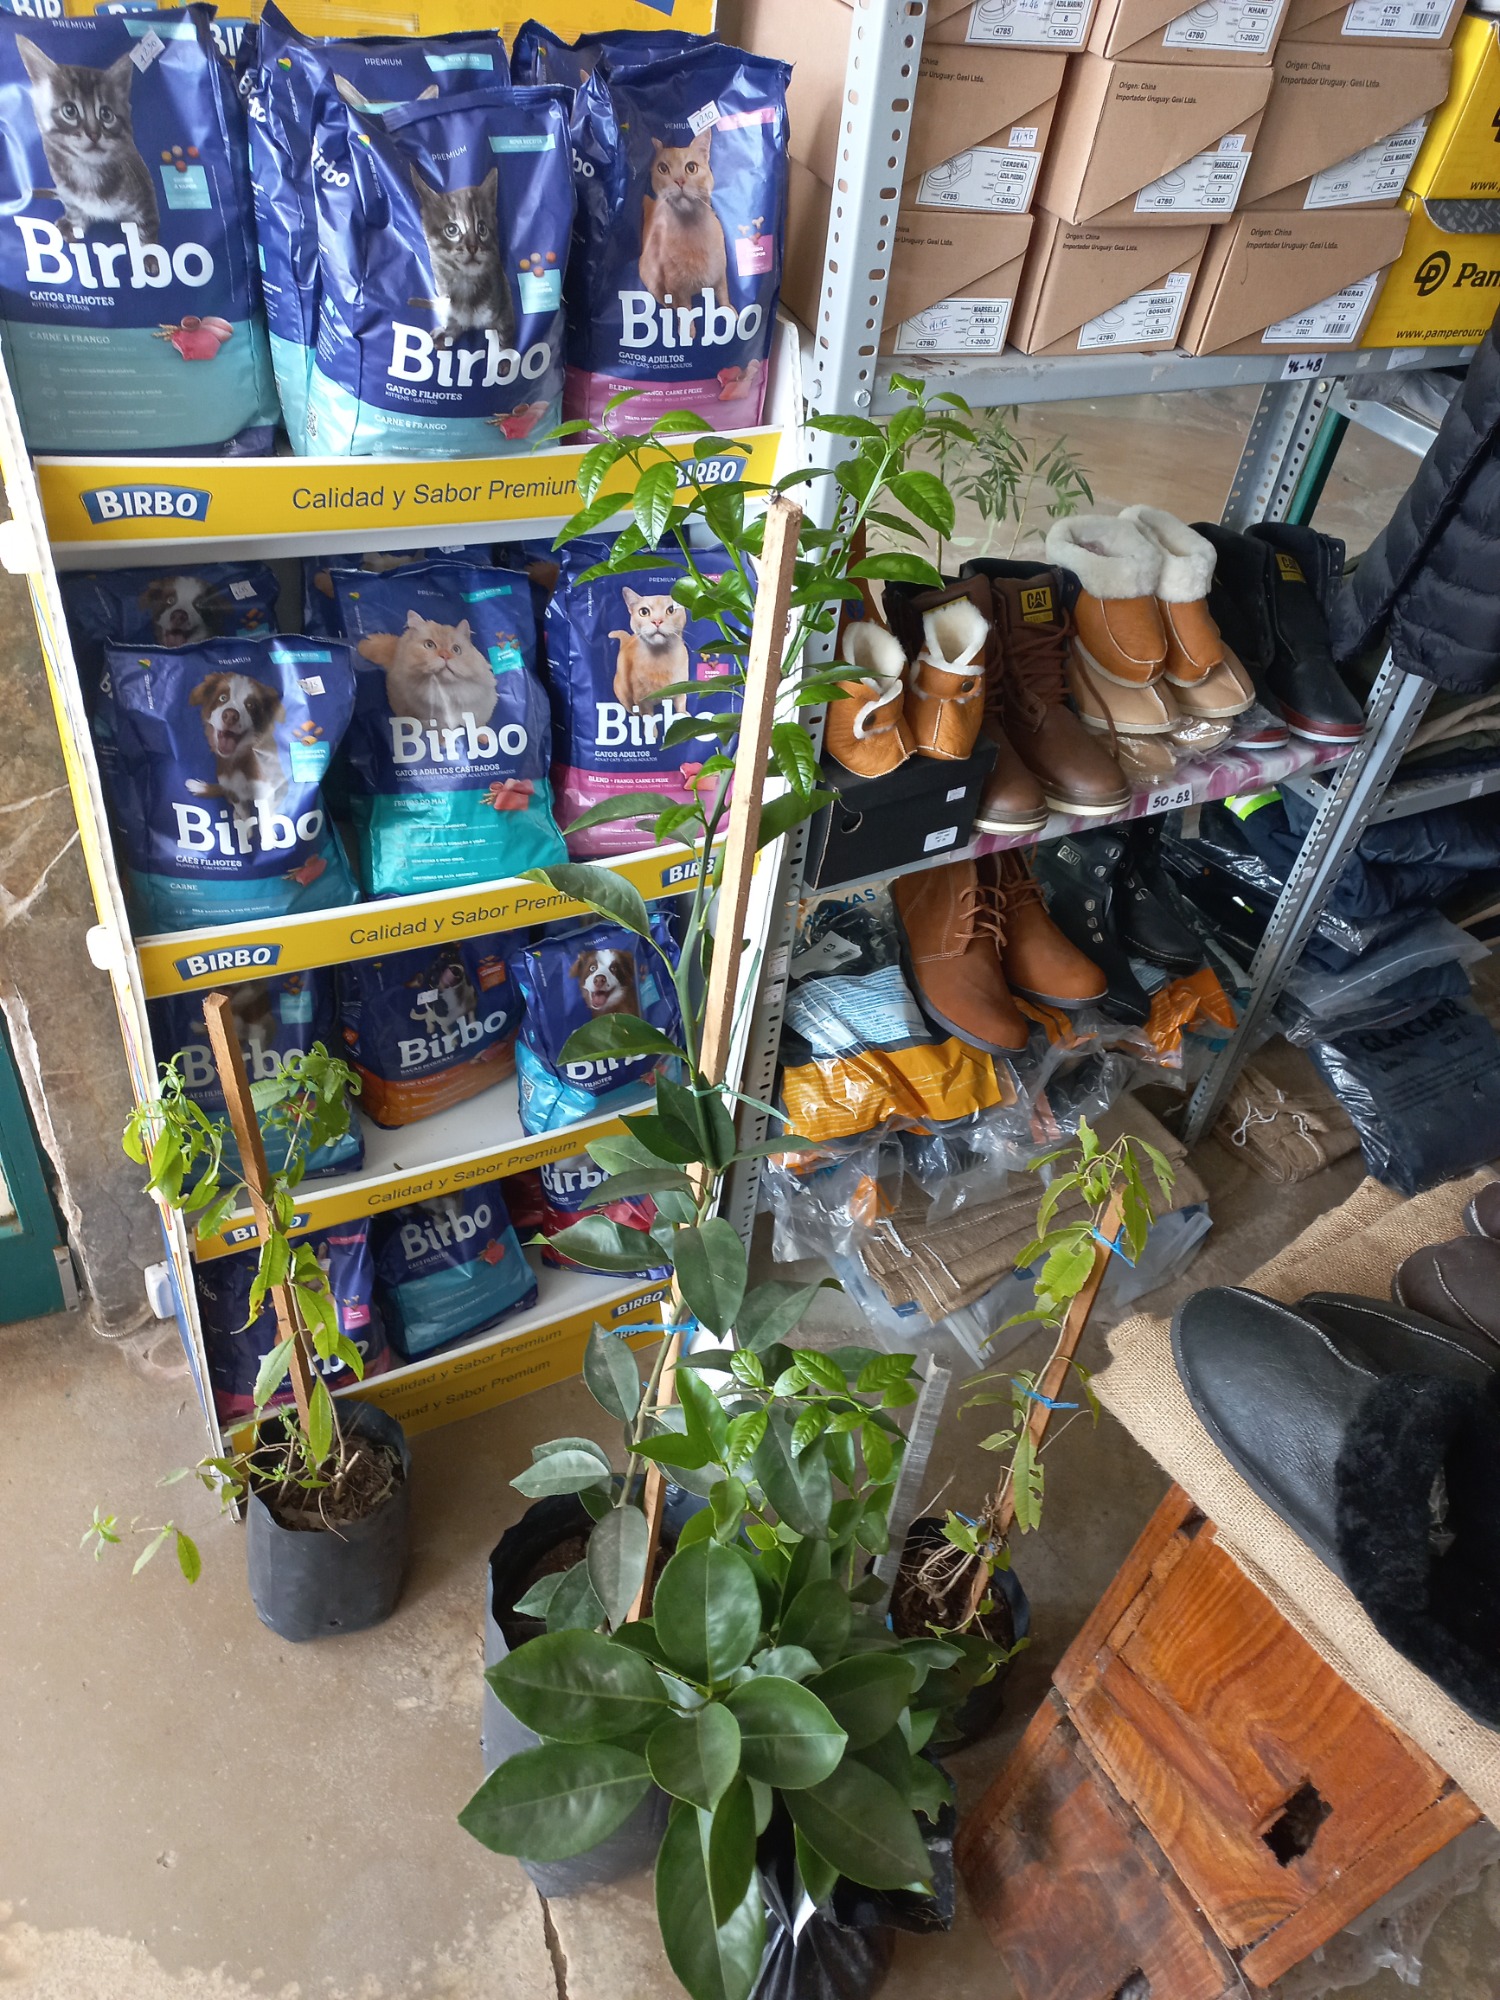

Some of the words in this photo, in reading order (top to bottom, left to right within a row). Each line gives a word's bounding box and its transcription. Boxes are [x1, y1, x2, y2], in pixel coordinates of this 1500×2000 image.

[1383, 6, 1401, 14] 4755
[52, 20, 97, 30] PREMIUM
[1187, 31, 1204, 39] 4780
[364, 57, 403, 67] PREMIUM
[1285, 60, 1310, 71] Origen:
[1311, 61, 1331, 70] China
[1119, 81, 1139, 90] Origen:
[1280, 75, 1319, 85] Importador
[1116, 93, 1146, 102] Importador
[1388, 138, 1416, 147] ANGRAS
[431, 145, 467, 161] PREMIUM
[1002, 160, 1028, 169] CERDEÑA
[1214, 161, 1239, 169] MARSELLA
[1377, 181, 1398, 189] 2-2020
[996, 196, 1016, 204] 1-2020
[1250, 228, 1273, 237] Origen:
[1274, 228, 1292, 236] China
[14, 215, 214, 289] Birbo
[1246, 241, 1280, 249] Importador
[1280, 241, 1308, 250] Uruguay:
[29, 290, 65, 303] GATOS
[66, 293, 115, 306] FILHOTES
[618, 287, 763, 348] Birbo
[29, 331, 62, 342] CARNE
[71, 335, 111, 345] FRANGO
[387, 320, 551, 388] Birbo
[618, 351, 647, 362] GATOS
[648, 354, 685, 364] ADULTOS
[1288, 357, 1323, 374] 46-48
[385, 382, 417, 397] GATOS
[418, 390, 463, 401] FILHOTES
[385, 391, 410, 402] KITTENS
[374, 414, 405, 427] CARNE
[411, 420, 447, 431] FRANGO
[292, 486, 385, 510] Calidad
[392, 489, 407, 511] y
[413, 482, 485, 505] Sabor
[95, 490, 199, 519] BIRBO
[1026, 590, 1047, 610] CAT
[389, 712, 528, 764] Birbo
[595, 750, 618, 758] GATOS
[618, 750, 650, 758] ADULTOS
[395, 769, 418, 777] GATOS
[419, 766, 454, 776] ADULTOS
[455, 763, 500, 774] CASTRADOS
[588, 775, 609, 783] BLEND
[1152, 789, 1190, 808] 50-52
[172, 799, 324, 855] Birbo
[200, 857, 243, 867] FILHOTES
[169, 882, 198, 890] CARNE
[350, 918, 427, 945] Calidad
[433, 917, 445, 933] y
[450, 903, 509, 926] Sabor
[187, 947, 271, 976] BIRBO
[398, 1010, 507, 1068] Birbo
[367, 1180, 433, 1206] Calidad
[438, 1177, 449, 1190] y
[453, 1162, 503, 1183] Sabor
[507, 1140, 577, 1168] Premium
[400, 1204, 491, 1261] Birbo
[616, 1290, 663, 1316] BIRBO
[378, 1373, 436, 1399] Calidad
[440, 1369, 449, 1381] y
[453, 1354, 497, 1374] Sabor
[500, 1328, 562, 1357] Premium
[433, 1400, 442, 1411] y
[446, 1384, 488, 1404] Sabor
[491, 1359, 551, 1388] Premium
